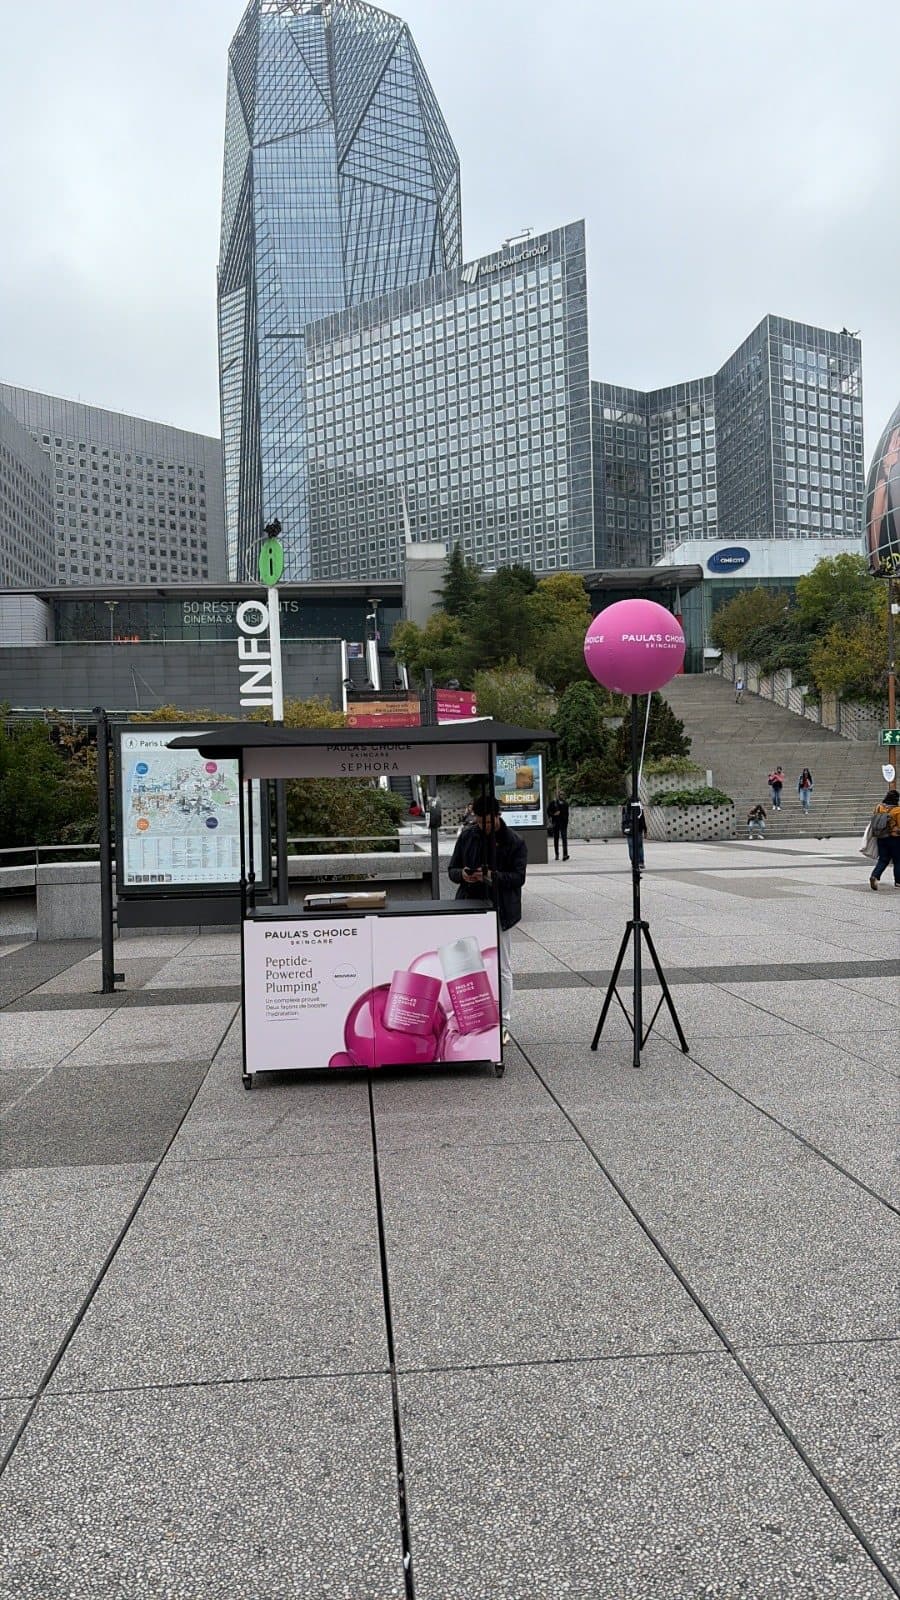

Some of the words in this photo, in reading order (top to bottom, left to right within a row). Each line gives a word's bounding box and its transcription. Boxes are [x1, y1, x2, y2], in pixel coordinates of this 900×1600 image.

[480, 244, 549, 275] ManpowerGroup
[183, 601, 200, 613] 50
[183, 614, 223, 624] CINEMA
[226, 614, 233, 623] &
[622, 633, 663, 642] PAULA'S
[237, 600, 273, 706] INFO
[140, 740, 159, 748] Paris
[340, 762, 399, 772] SEPHORA
[264, 930, 309, 940] PAULA'S
[313, 928, 358, 938] CHOICE
[290, 938, 333, 946] SKINCARE
[265, 955, 312, 968] Peptide-
[265, 967, 313, 980] Powered
